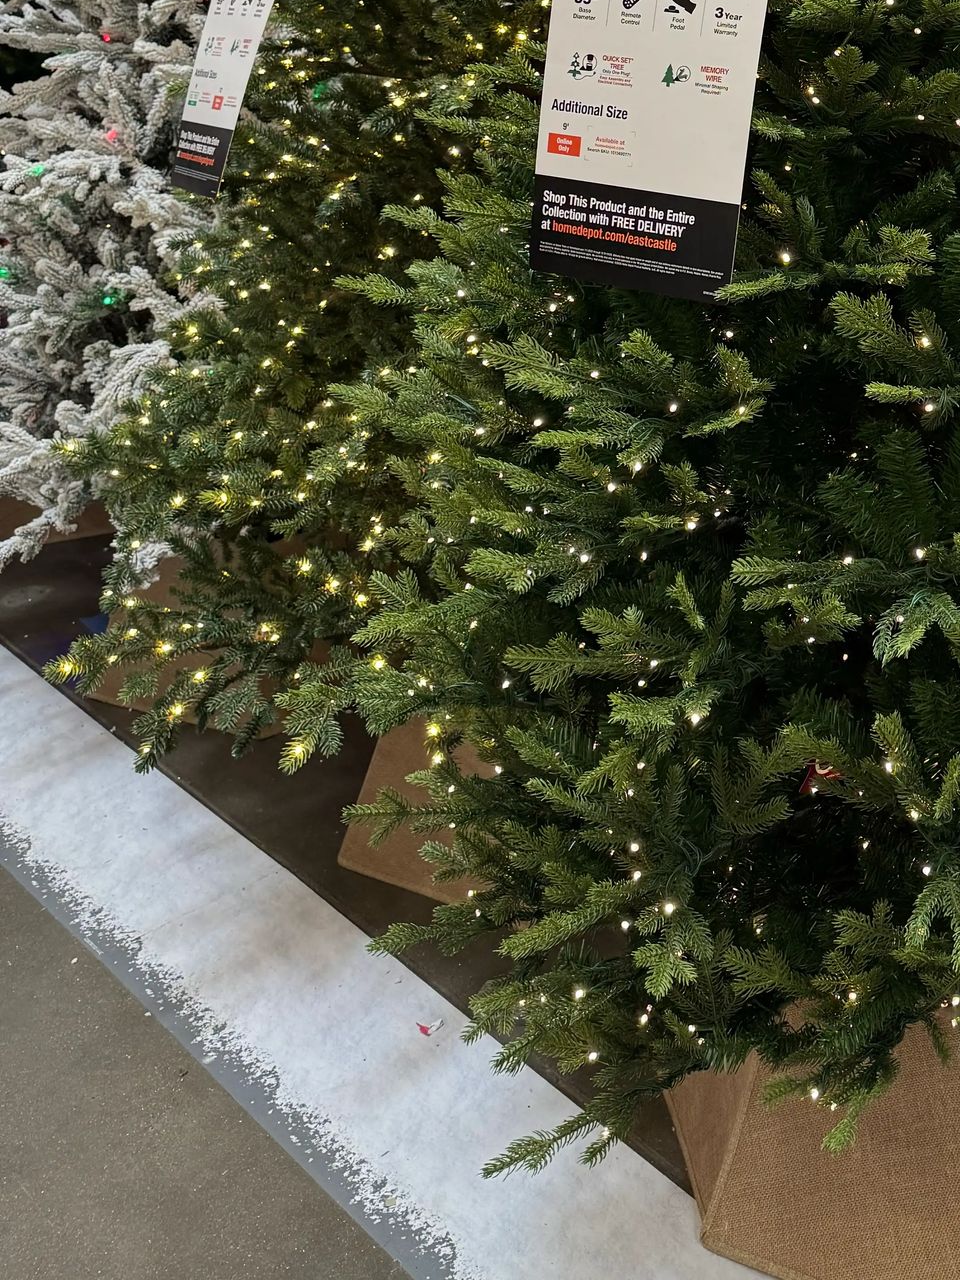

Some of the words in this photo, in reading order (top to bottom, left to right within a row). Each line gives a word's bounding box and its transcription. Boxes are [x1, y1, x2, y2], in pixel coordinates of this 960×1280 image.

[578, 6, 591, 14] Base
[714, 7, 724, 19] 3
[724, 11, 743, 21] Year
[573, 13, 596, 21] Diameter
[621, 11, 641, 20] Remote
[672, 16, 685, 24] Foot
[620, 18, 641, 26] Control
[716, 21, 737, 29] Limited
[670, 23, 685, 31] Pedal
[714, 28, 738, 37] Warranty
[602, 54, 620, 63] QUICK
[700, 65, 730, 75] MEMORY
[705, 74, 722, 83] WIRE
[551, 98, 603, 118] Additional
[606, 105, 628, 120] Size
[556, 136, 573, 145] Online
[595, 136, 619, 145] Available
[558, 144, 570, 153] Only
[543, 190, 567, 206] Shop
[568, 194, 588, 208] This
[590, 197, 627, 215] Product
[628, 204, 646, 217] and
[648, 206, 664, 220] the
[666, 209, 695, 225] Entire
[542, 205, 587, 223] Collection
[589, 212, 609, 226] with
[611, 215, 635, 231] FREE
[541, 220, 551, 231] at
[552, 220, 678, 252] homedepot.com/eastcastle
